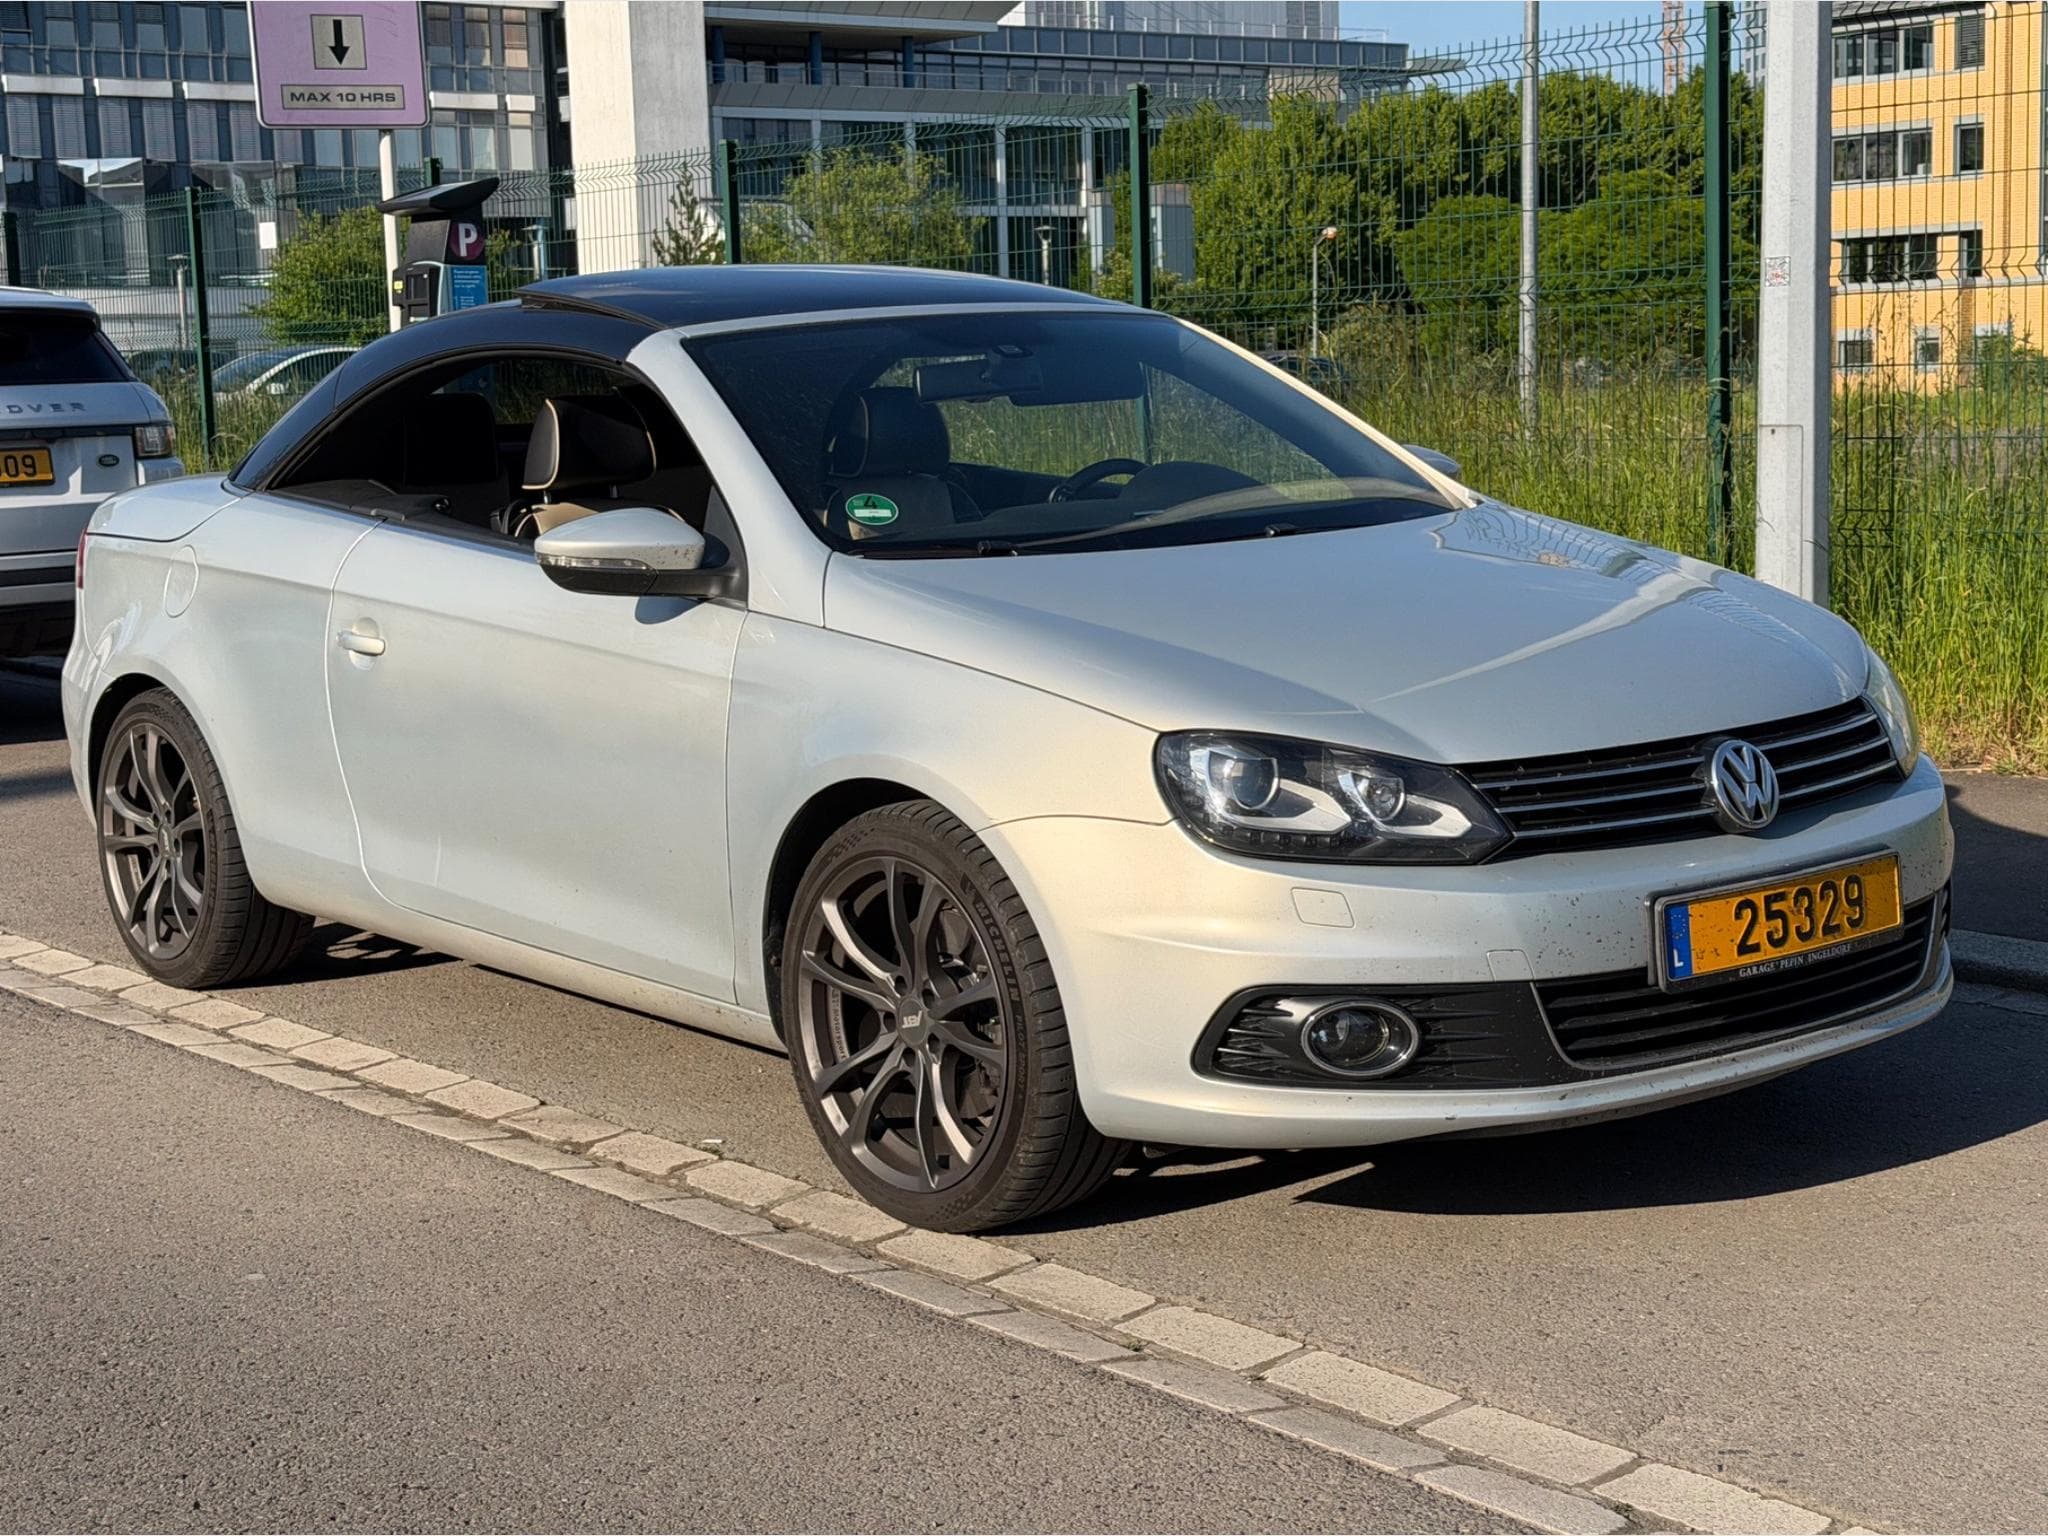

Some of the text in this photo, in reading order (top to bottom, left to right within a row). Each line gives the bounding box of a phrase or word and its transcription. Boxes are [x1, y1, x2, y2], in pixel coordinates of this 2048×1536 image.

[290, 92, 396, 102] MAX 10 HRS
[458, 223, 478, 257] P
[0, 402, 86, 414] OVER
[0, 454, 37, 478] 09
[864, 496, 878, 509] 4
[1673, 874, 1865, 967] L 25329
[975, 901, 1021, 1002] MICHELIN
[1739, 962, 1776, 978] GARAGE
